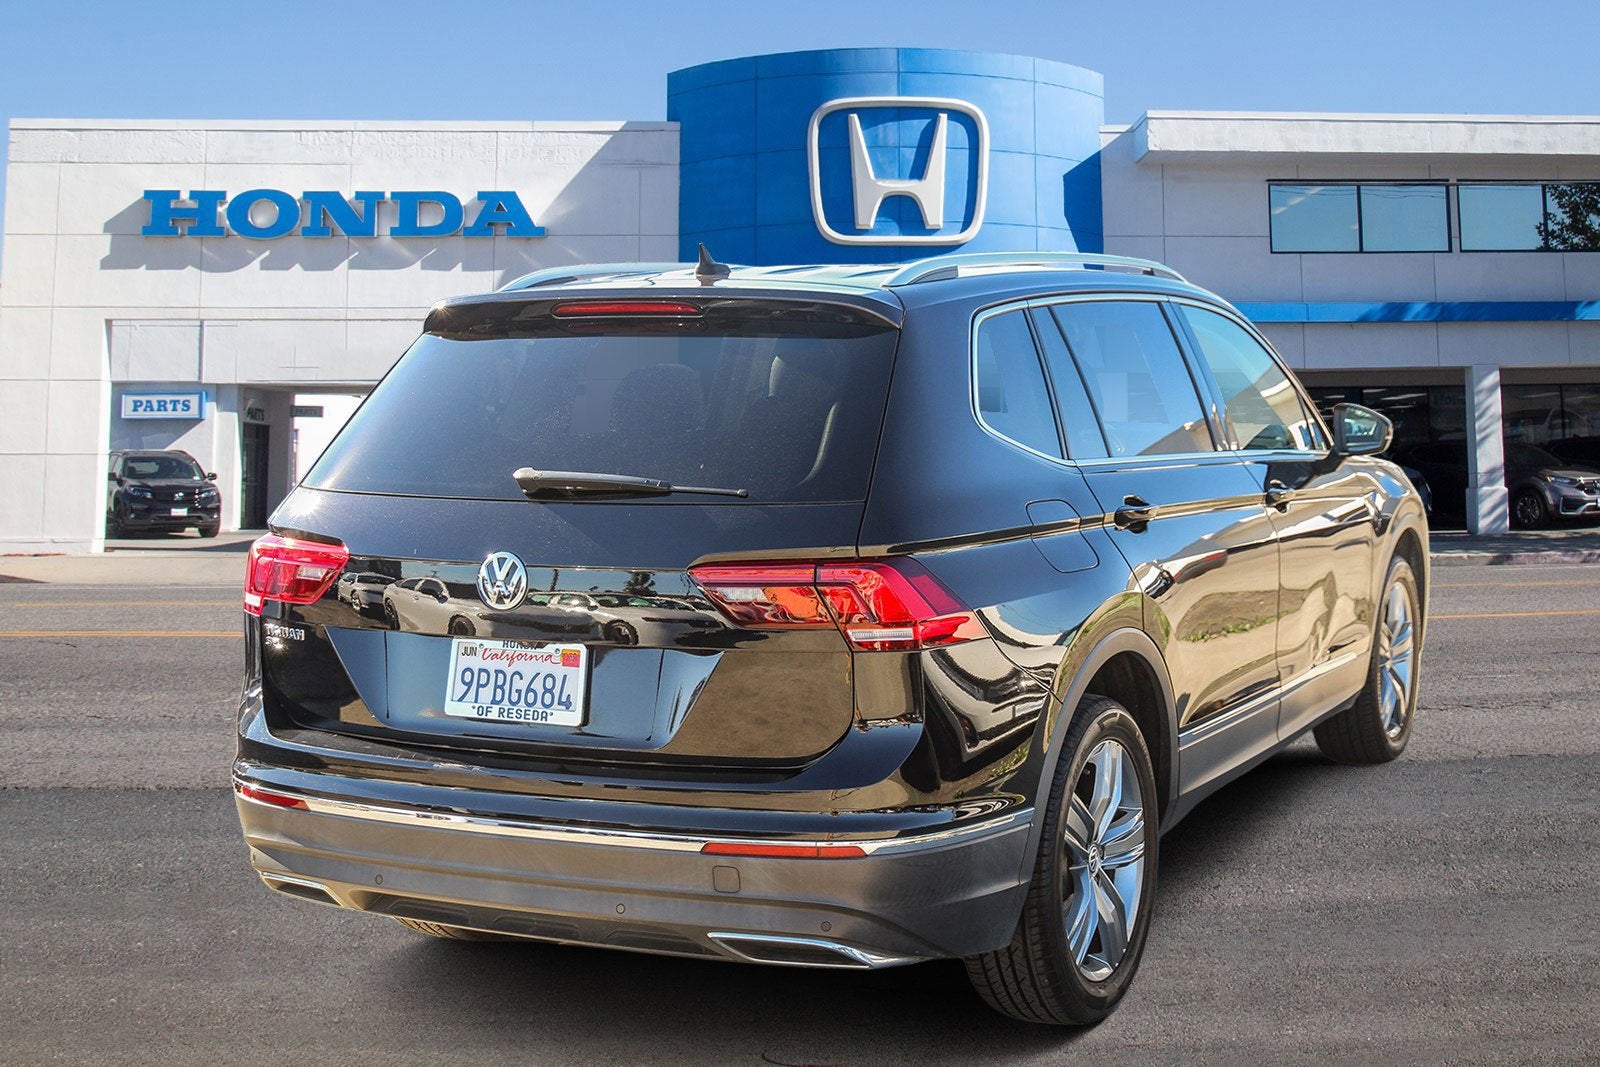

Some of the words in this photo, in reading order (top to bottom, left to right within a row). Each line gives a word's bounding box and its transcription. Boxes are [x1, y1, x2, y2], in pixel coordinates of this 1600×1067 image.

[141, 188, 547, 240] HONDA
[131, 399, 191, 413] PARTS
[461, 646, 477, 657] JUN
[502, 640, 537, 650] HON
[481, 647, 561, 667] California
[457, 667, 573, 710] 9PBG684
[476, 705, 493, 717] OF
[498, 706, 548, 722] RESEDA
